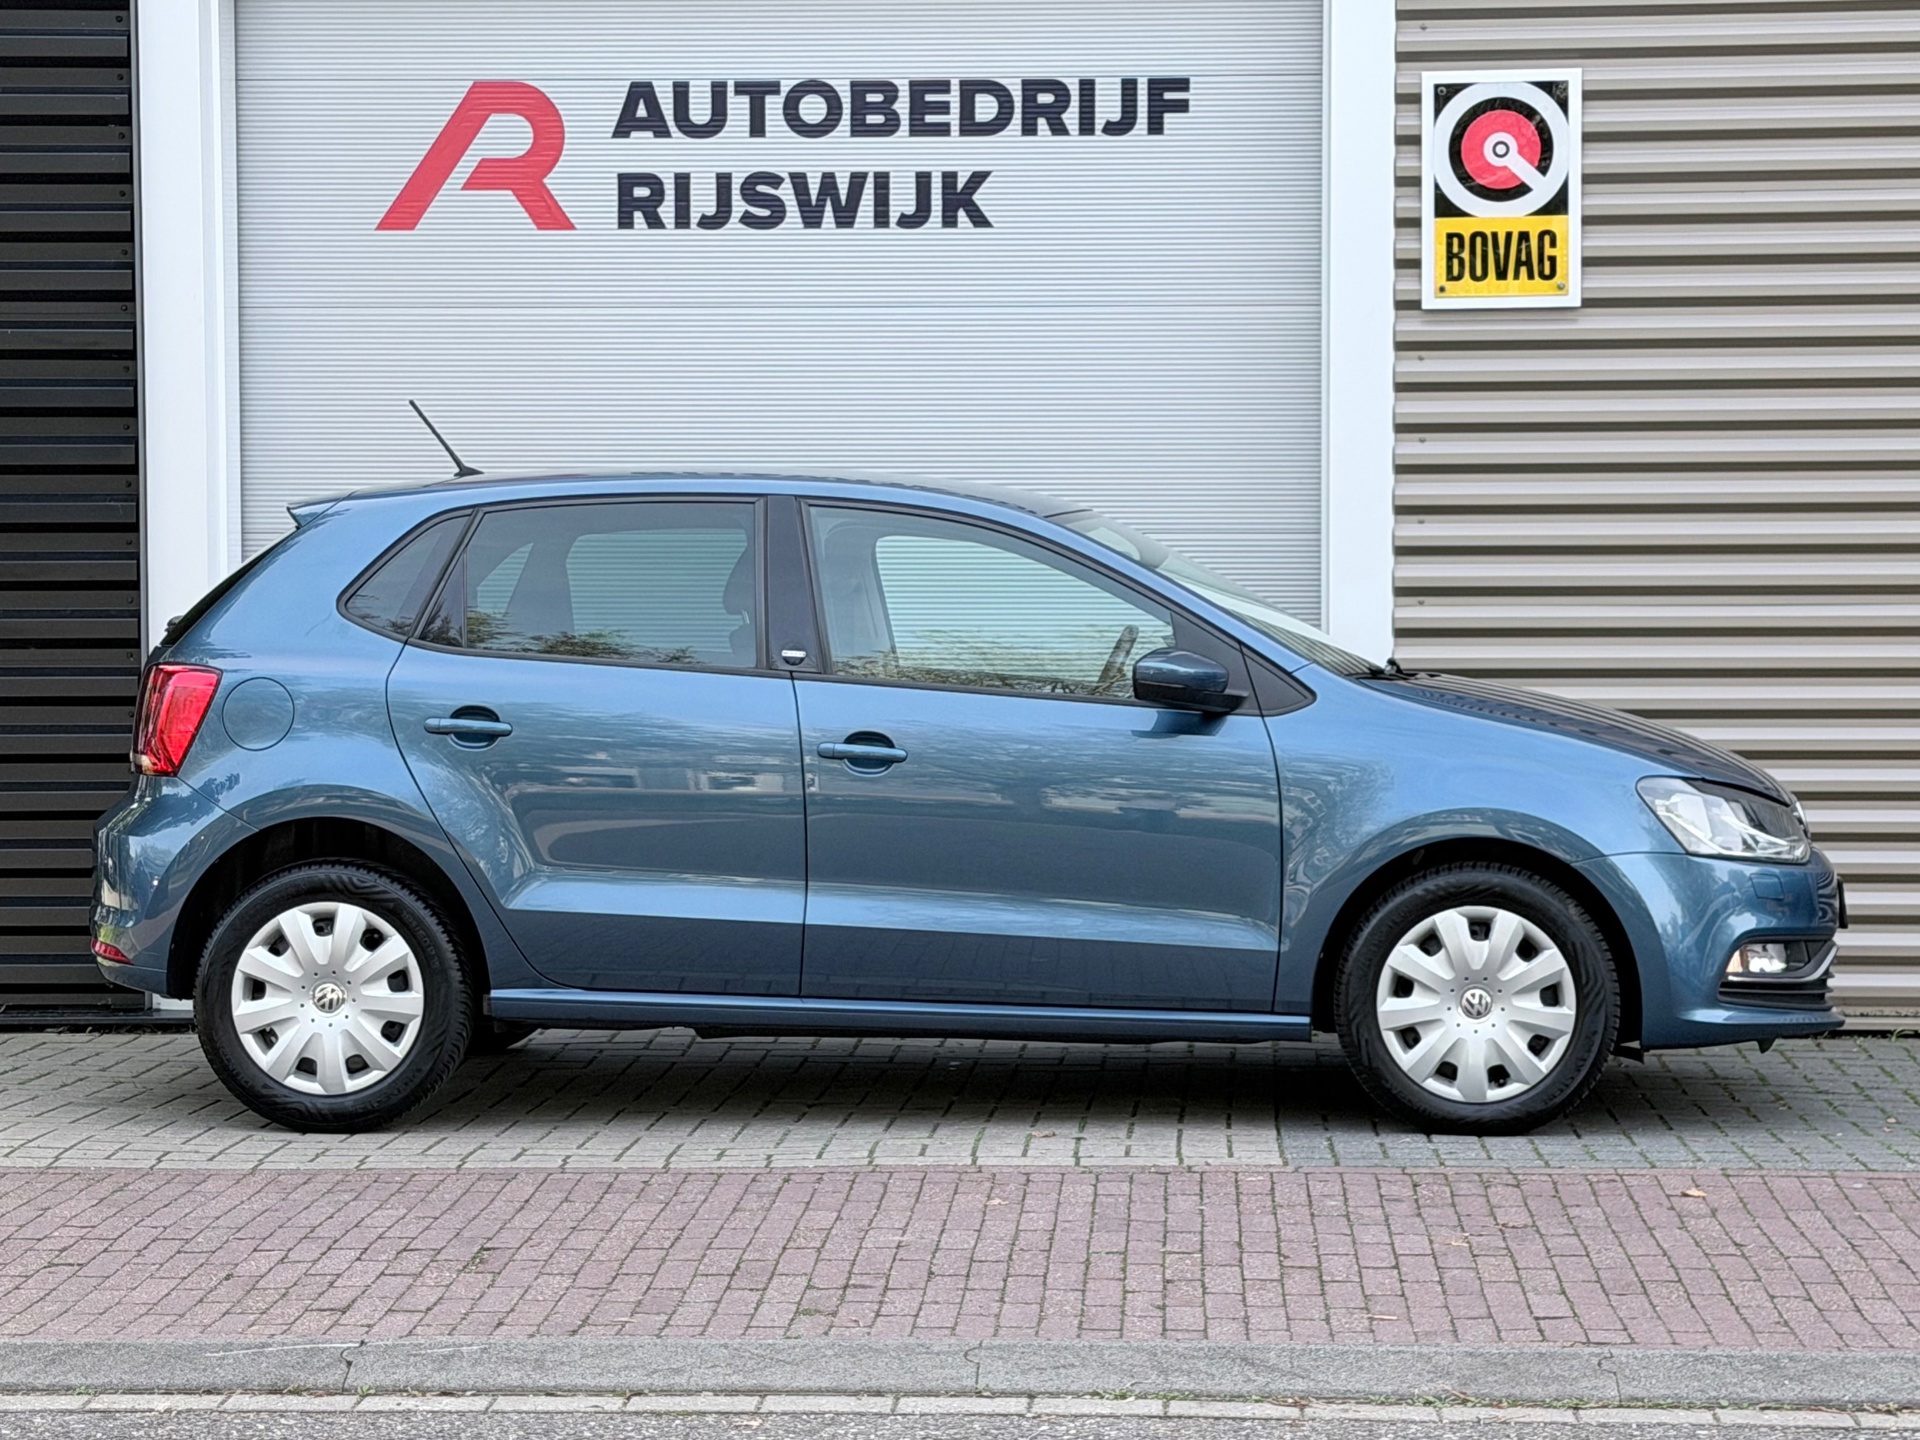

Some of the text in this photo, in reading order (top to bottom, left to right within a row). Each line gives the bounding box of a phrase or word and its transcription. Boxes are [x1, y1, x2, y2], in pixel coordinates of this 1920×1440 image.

[611, 77, 1191, 139] AUTOBEDRIJF
[617, 171, 994, 231] RIJSWIJK
[1445, 229, 1558, 282] BOVAG
[1460, 988, 1492, 1019] VW
